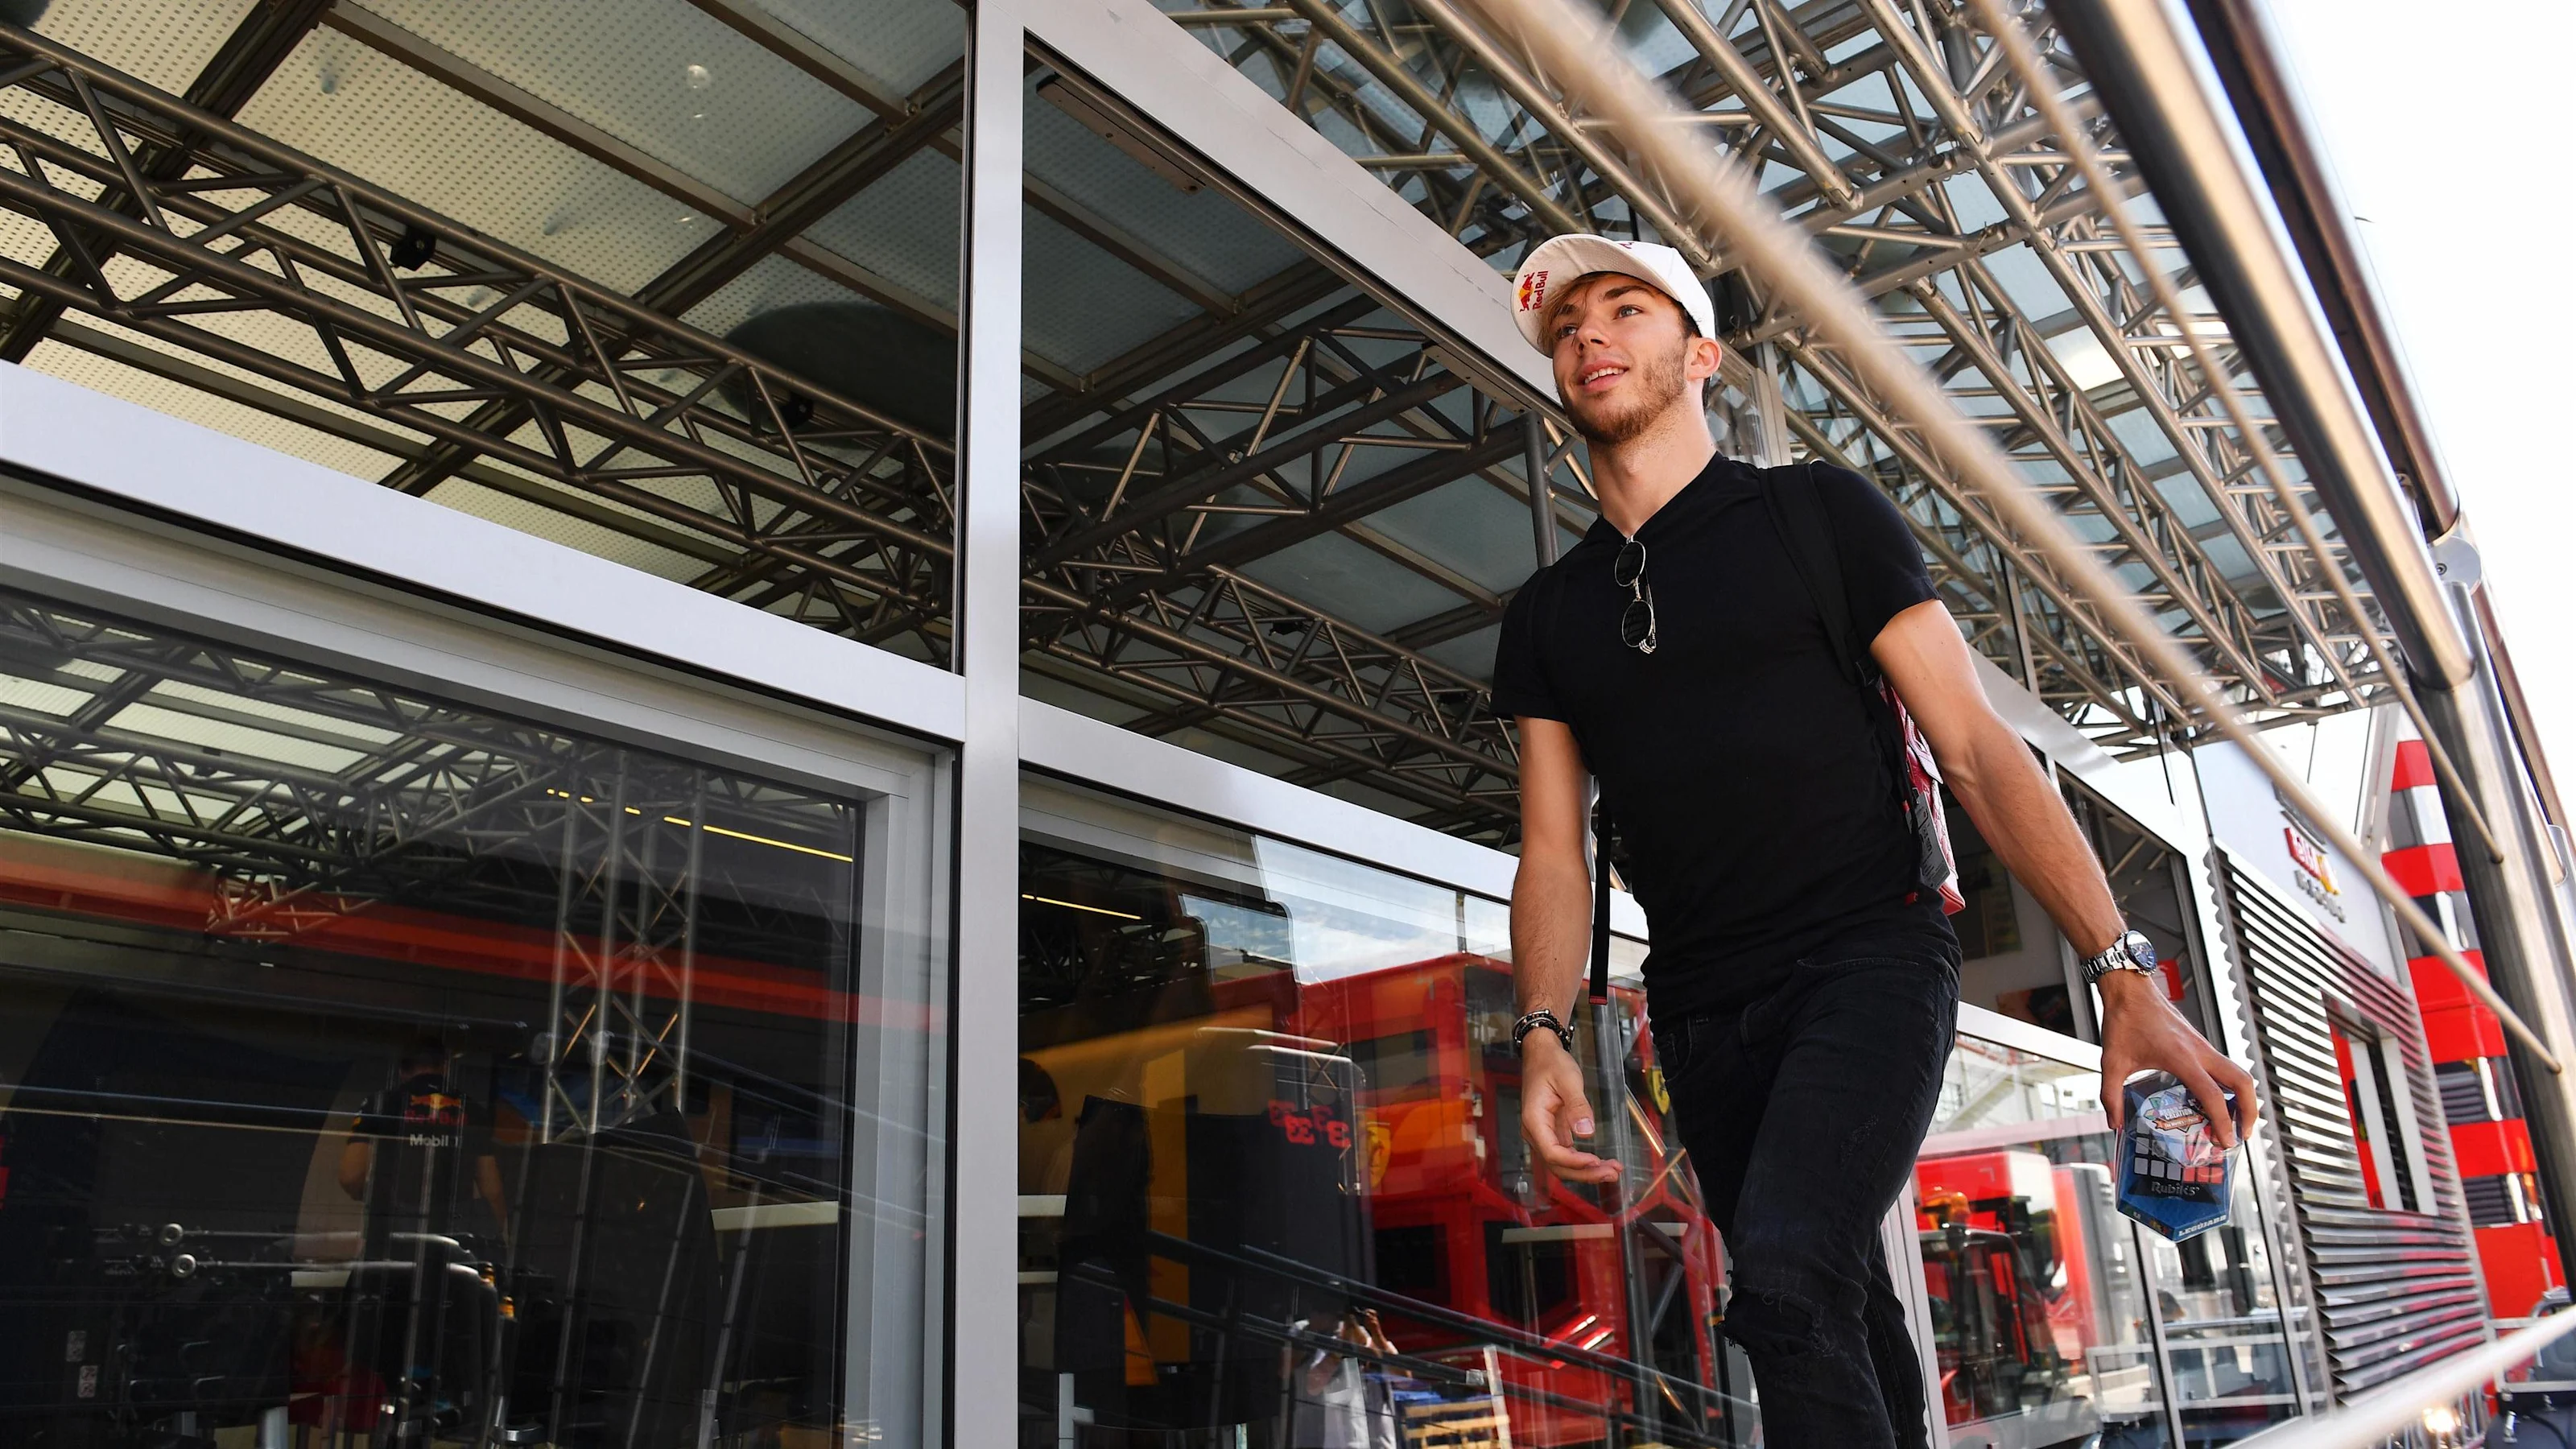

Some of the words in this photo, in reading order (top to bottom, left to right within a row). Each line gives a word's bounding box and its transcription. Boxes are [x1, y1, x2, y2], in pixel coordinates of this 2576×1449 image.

[1535, 270, 1549, 289] Bull
[1533, 289, 1544, 310] Red
[409, 1133, 449, 1148] Mobil
